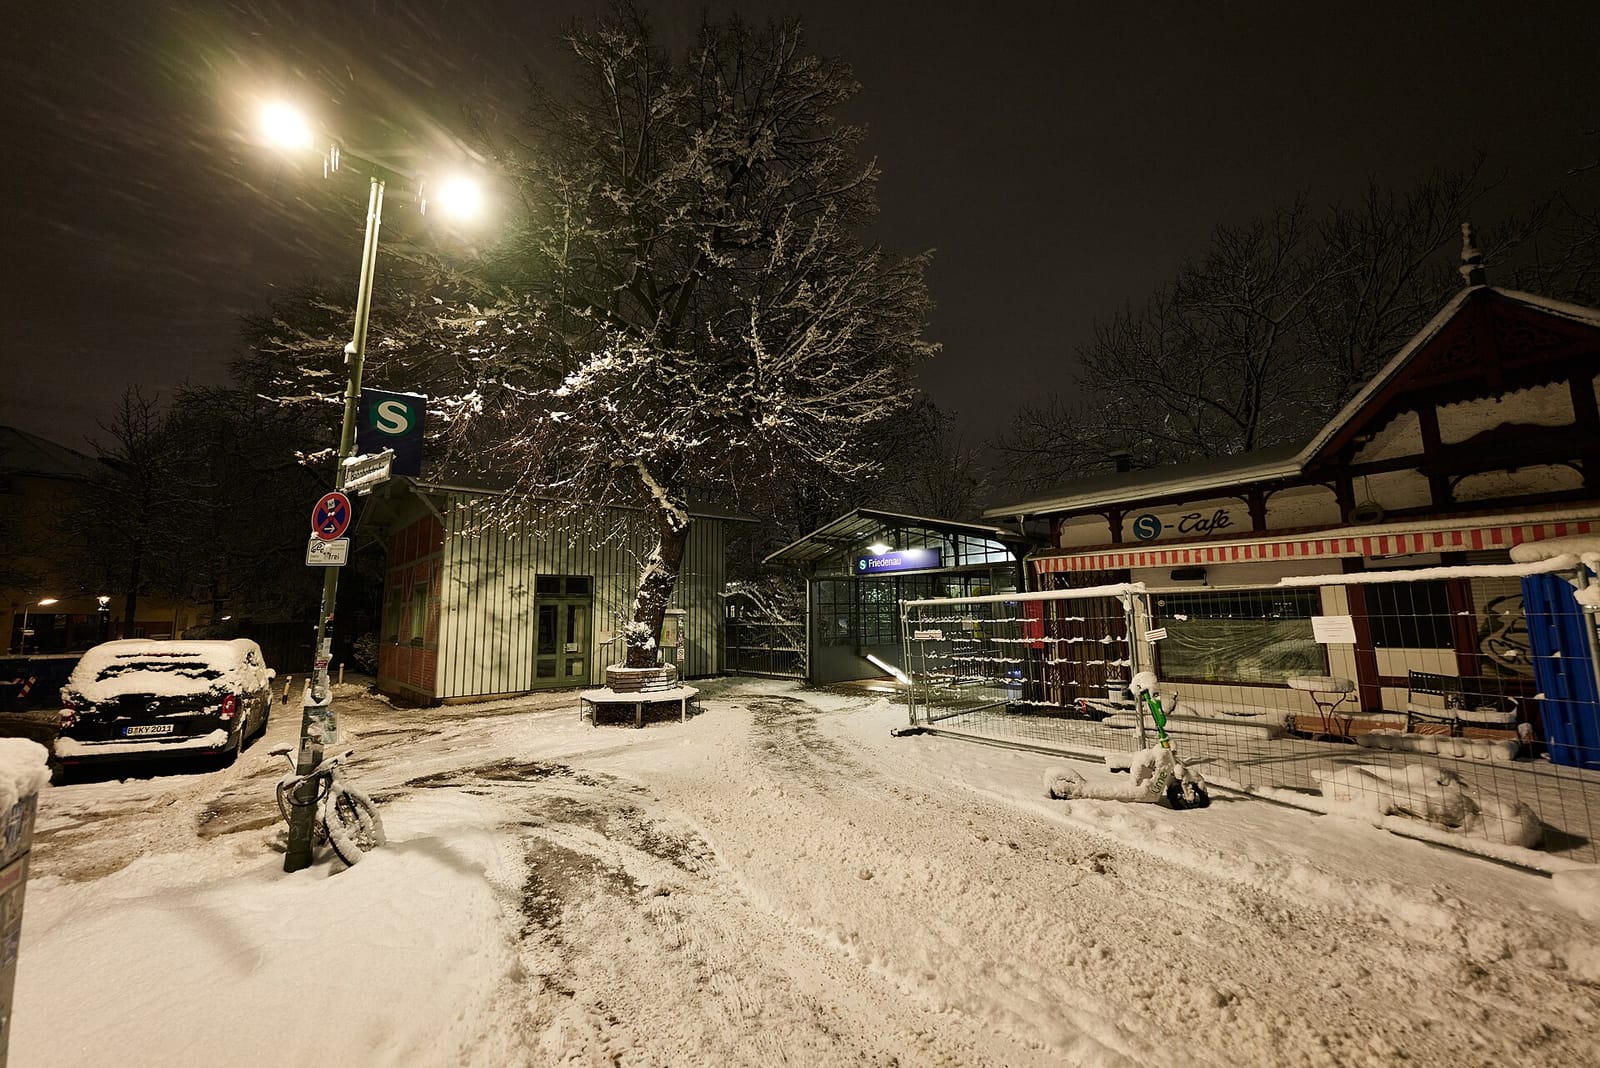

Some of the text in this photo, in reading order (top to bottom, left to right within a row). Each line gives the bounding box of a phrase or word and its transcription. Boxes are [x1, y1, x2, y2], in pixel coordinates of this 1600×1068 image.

[377, 401, 408, 434] S
[1178, 509, 1234, 536] Café
[868, 557, 902, 568] Friedenau
